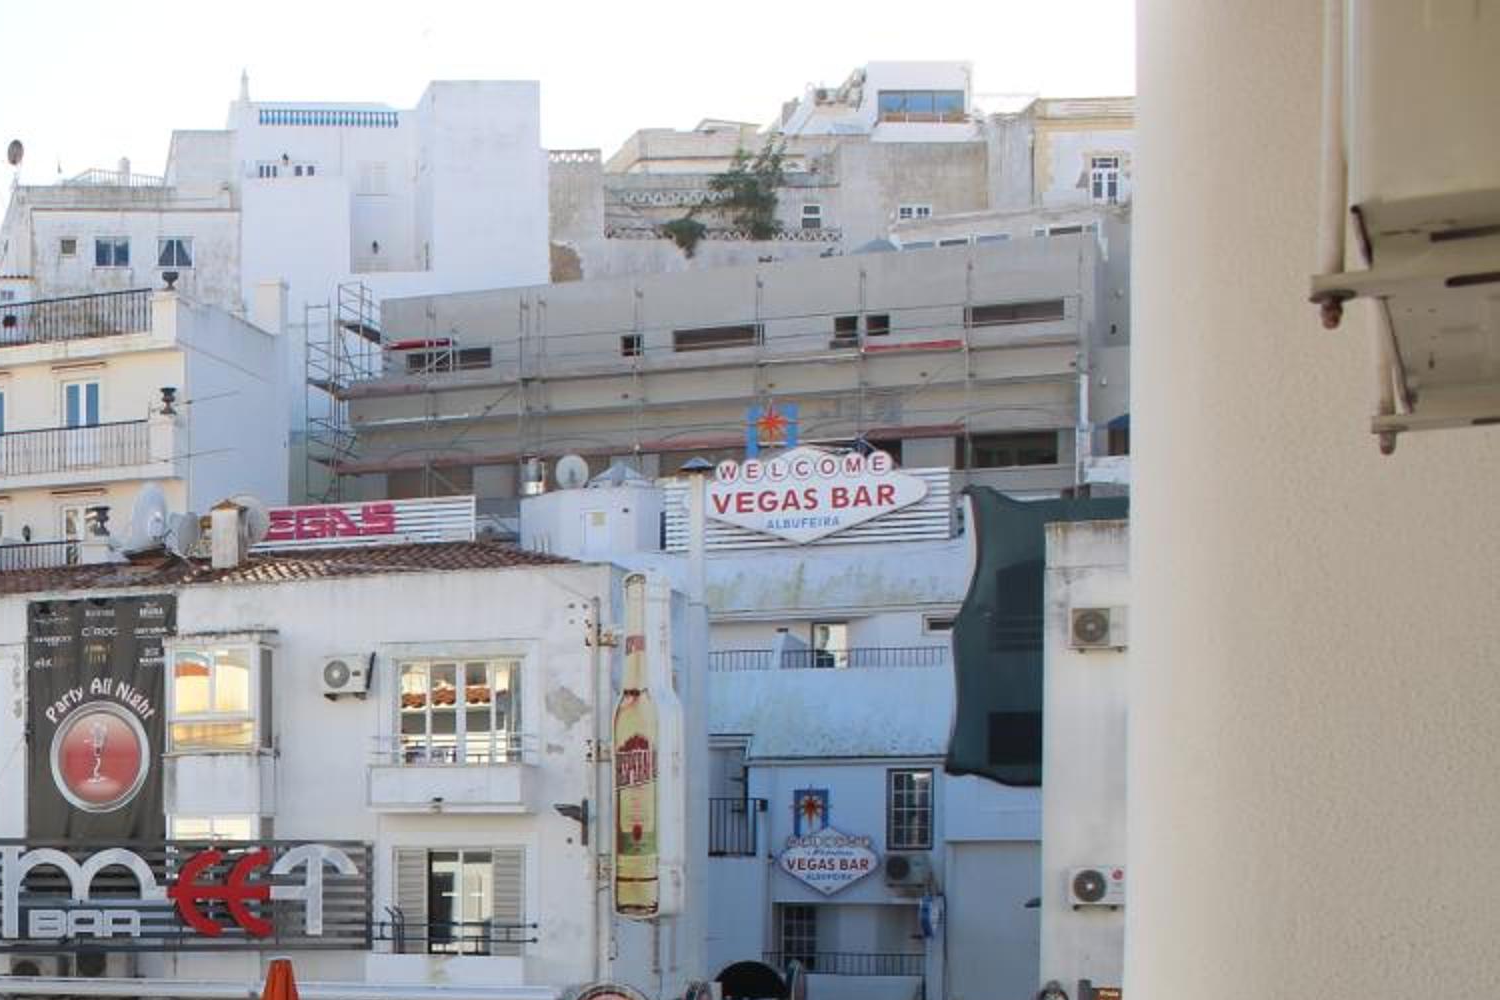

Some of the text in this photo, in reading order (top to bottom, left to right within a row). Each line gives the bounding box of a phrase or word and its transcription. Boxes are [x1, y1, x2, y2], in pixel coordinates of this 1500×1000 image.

[718, 455, 886, 482] WELCOME
[712, 484, 896, 515] VEGAS BAR
[766, 515, 840, 530] ALBUFEIRA
[45, 677, 156, 725] Party All Night
[787, 857, 869, 871] VEGAS BAR
[27, 908, 142, 938] BAR
